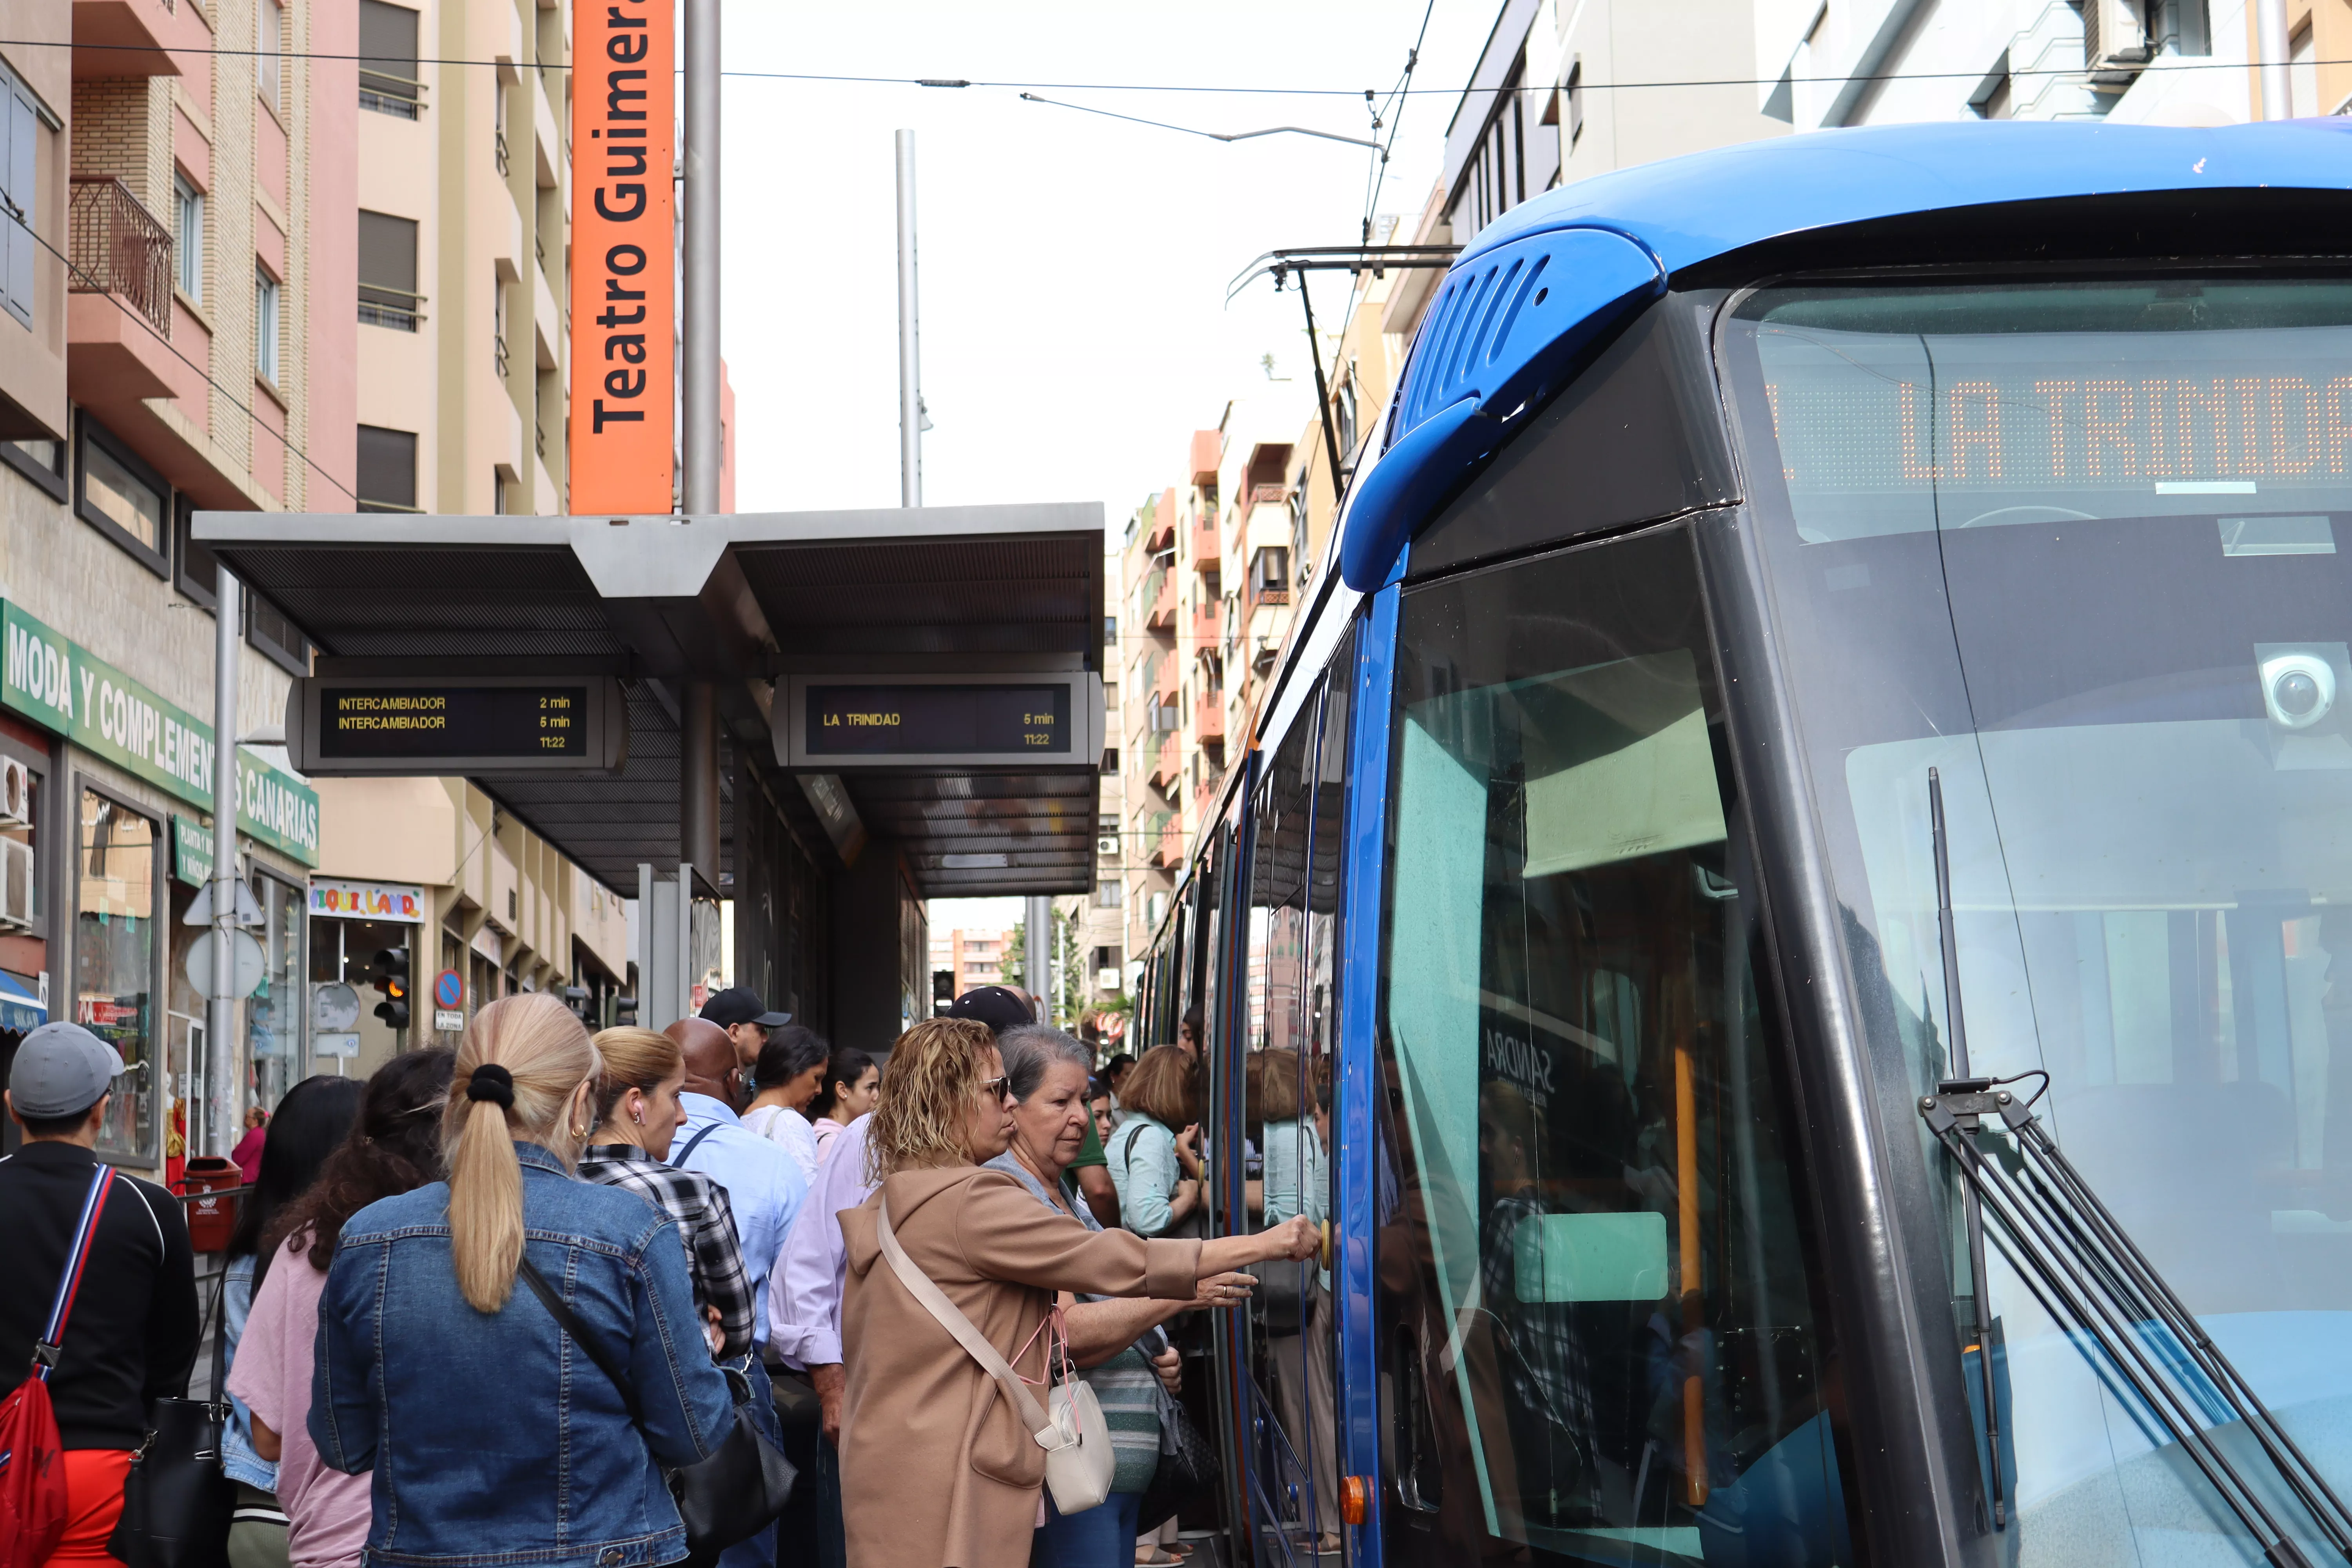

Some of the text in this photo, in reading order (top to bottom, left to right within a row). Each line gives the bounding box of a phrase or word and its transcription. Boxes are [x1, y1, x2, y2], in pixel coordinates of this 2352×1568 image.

[591, 0, 648, 434] Teatro Guimer
[1901, 381, 2002, 479] LA
[339, 697, 570, 710] INTERCAMBIADOR 2 min
[339, 716, 570, 730] INTERCAMBIADOR 5 min
[824, 713, 1054, 726] LA TRINIDAD 5 min
[9, 622, 316, 851] MODA Y COMPLEMENS CANARIAS
[540, 737, 565, 748] 11:22
[1024, 734, 1049, 745] 11:22
[181, 824, 201, 851] PLANTA
[182, 854, 186, 873] Y
[366, 890, 414, 915] LAND
